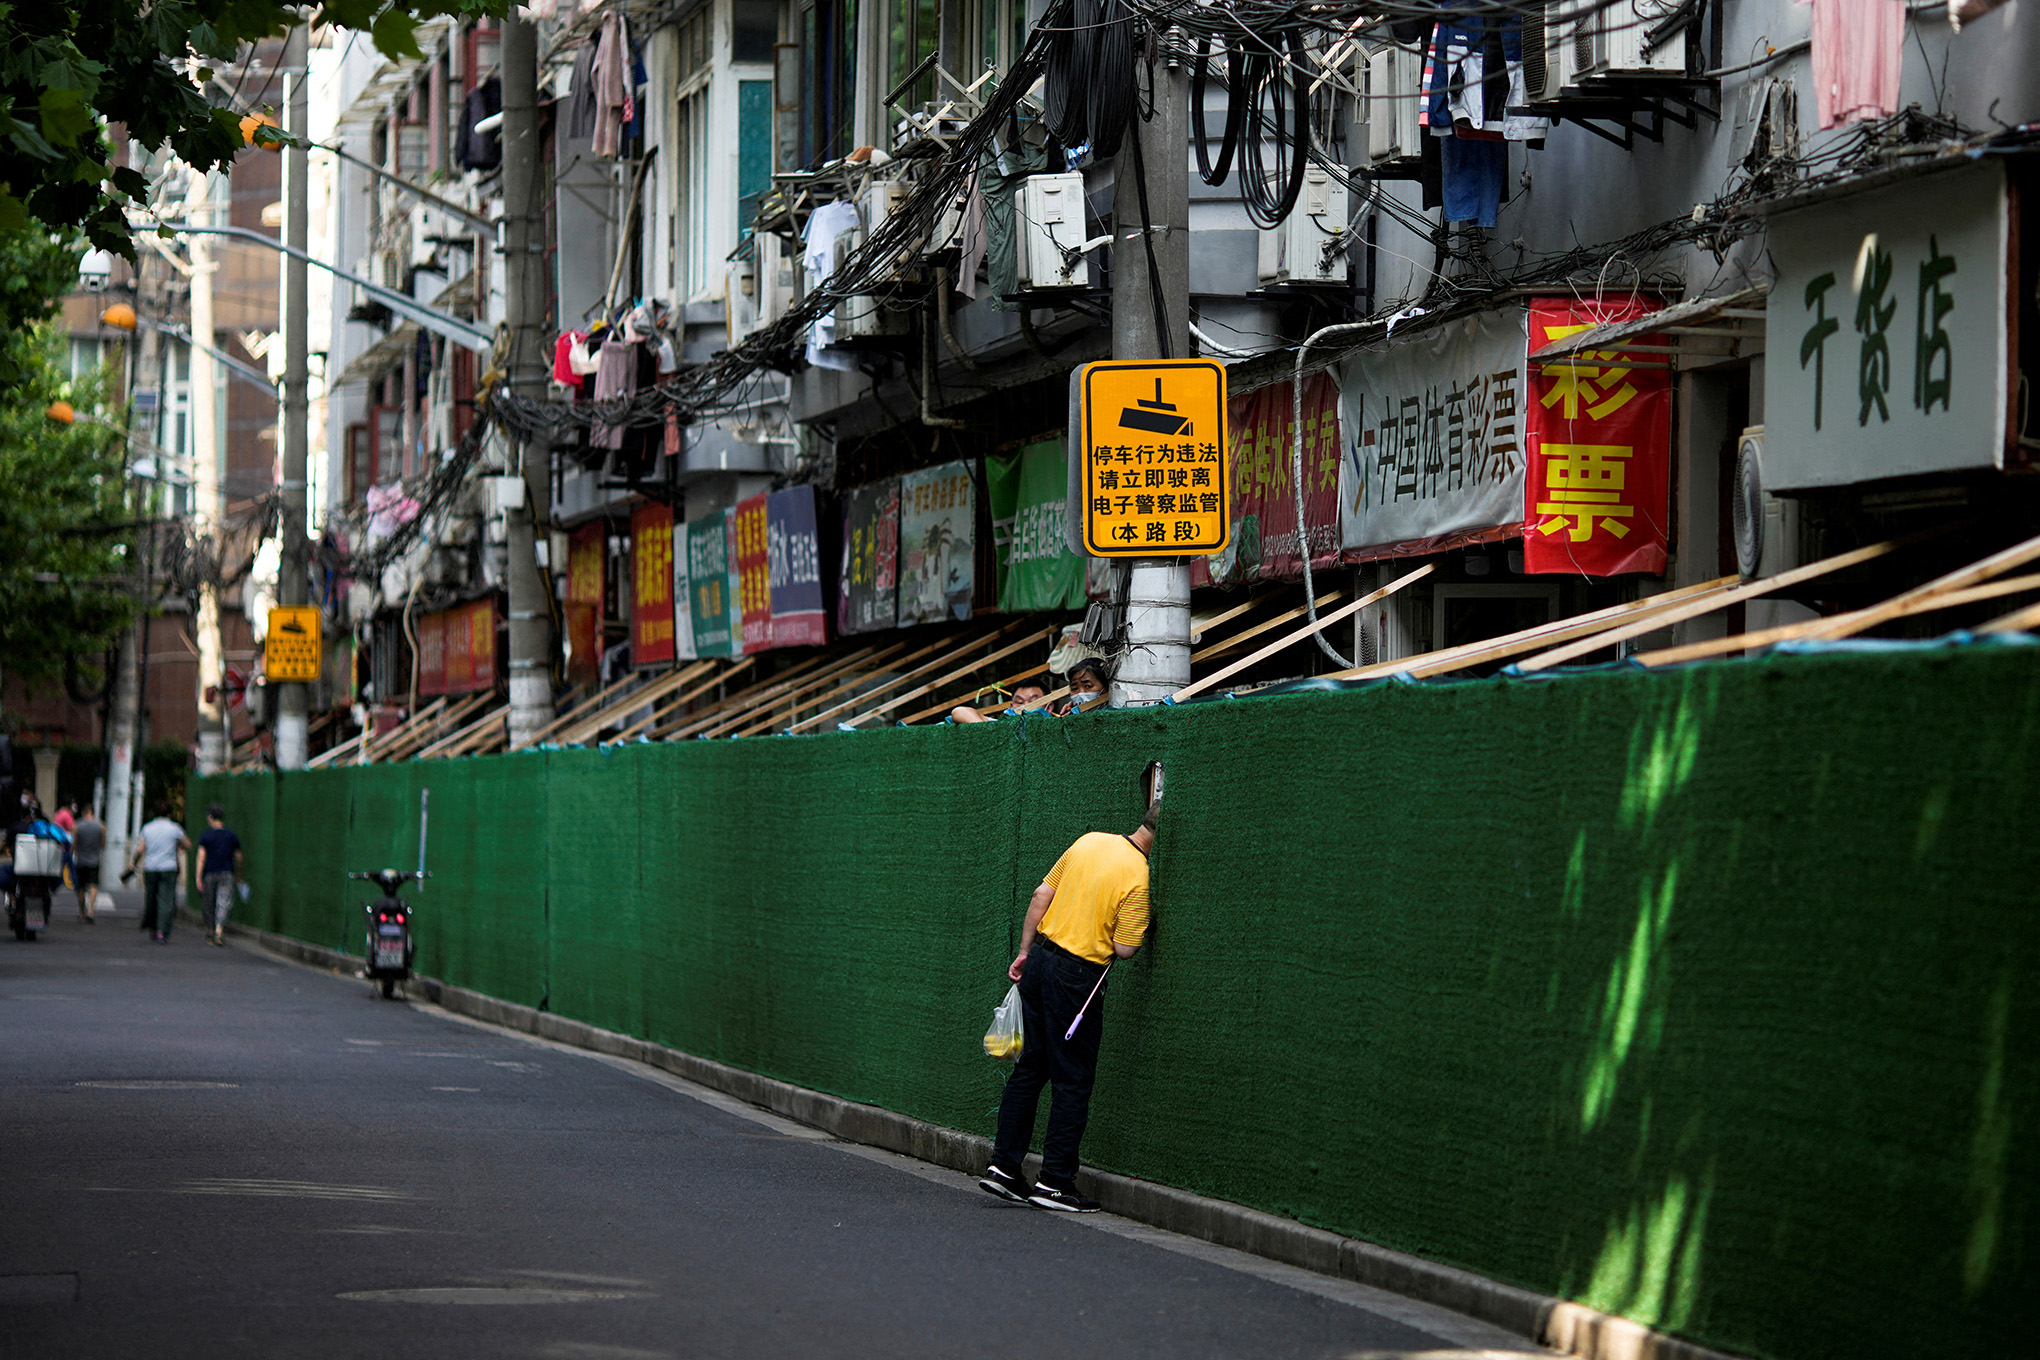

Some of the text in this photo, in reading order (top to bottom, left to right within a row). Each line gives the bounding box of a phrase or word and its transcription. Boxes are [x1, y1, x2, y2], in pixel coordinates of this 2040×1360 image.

[1800, 233, 1957, 432] 干货店
[1093, 443, 1218, 466] 停车行为违法
[1377, 367, 1518, 506] 中国体育彩票
[1536, 321, 1639, 543] 彩票
[1093, 492, 1219, 515] 电子警察监管
[1098, 467, 1211, 490] 请立即驶离
